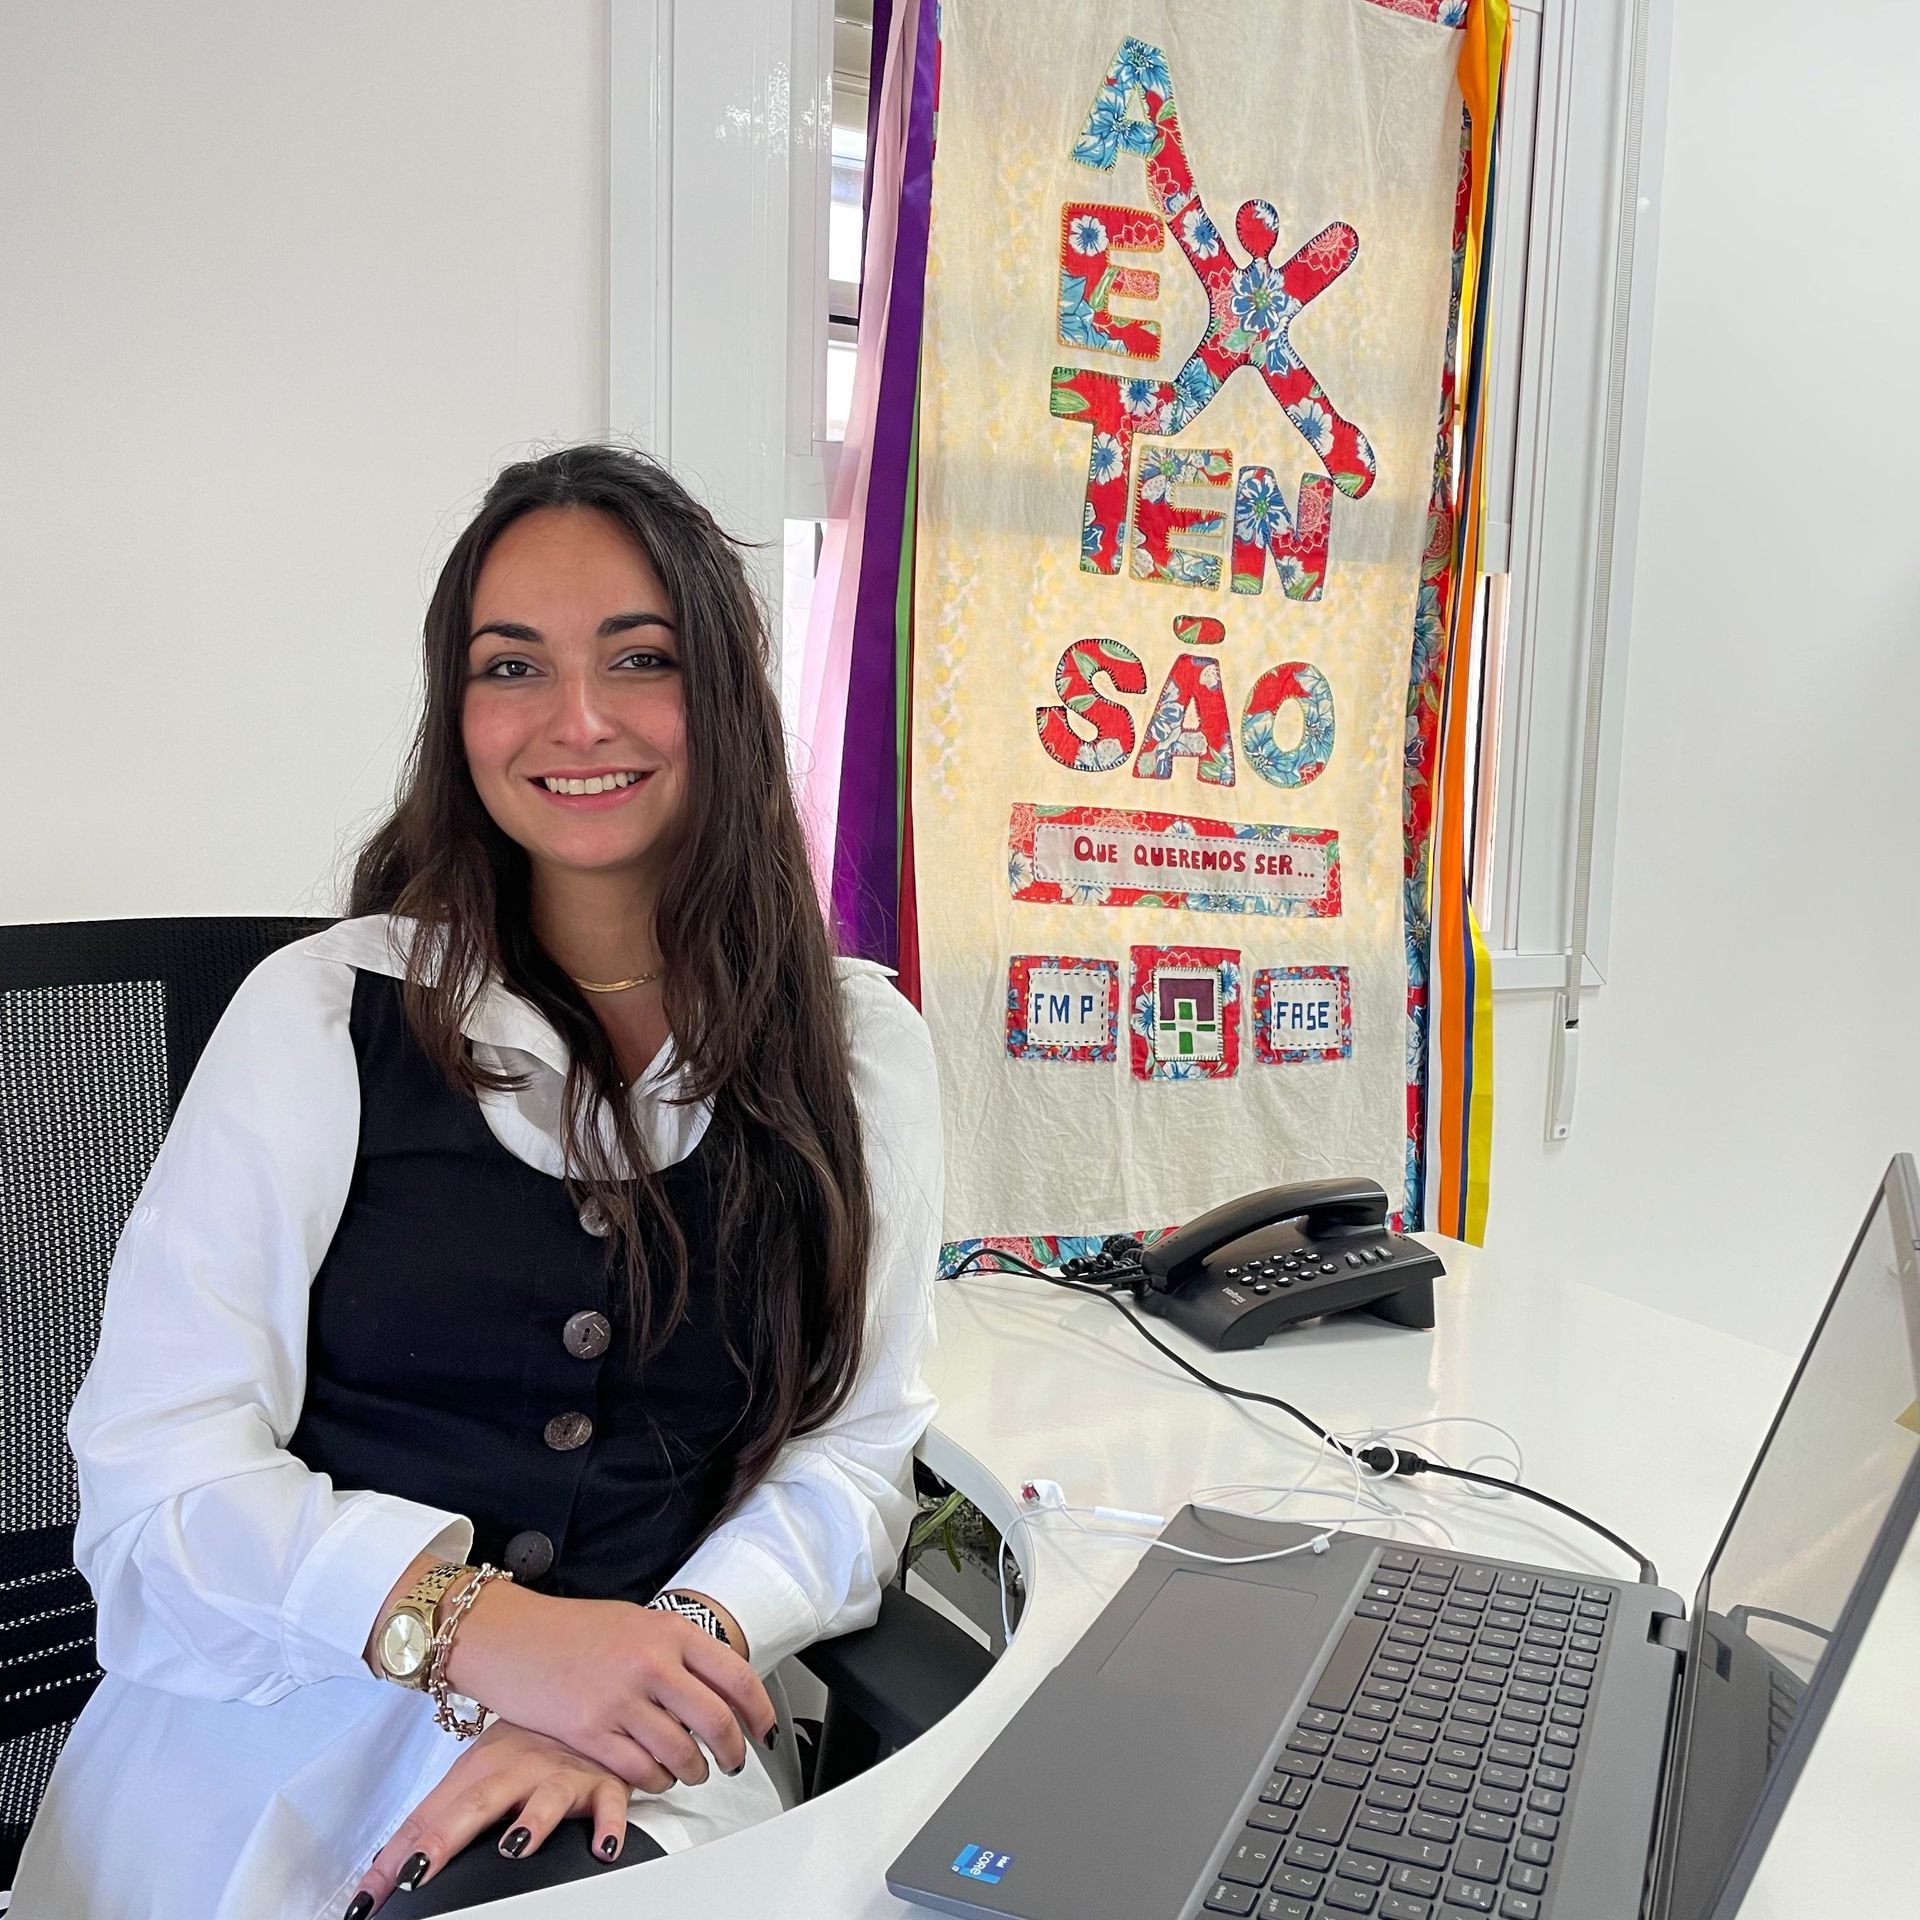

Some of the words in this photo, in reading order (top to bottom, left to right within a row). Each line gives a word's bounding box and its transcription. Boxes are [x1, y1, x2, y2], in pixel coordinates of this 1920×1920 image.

[1069, 35, 1199, 222] A
[1036, 615, 1336, 789] SÃO
[1133, 844, 1247, 873] QUEREMOS
[1276, 1000, 1330, 1031] FASE
